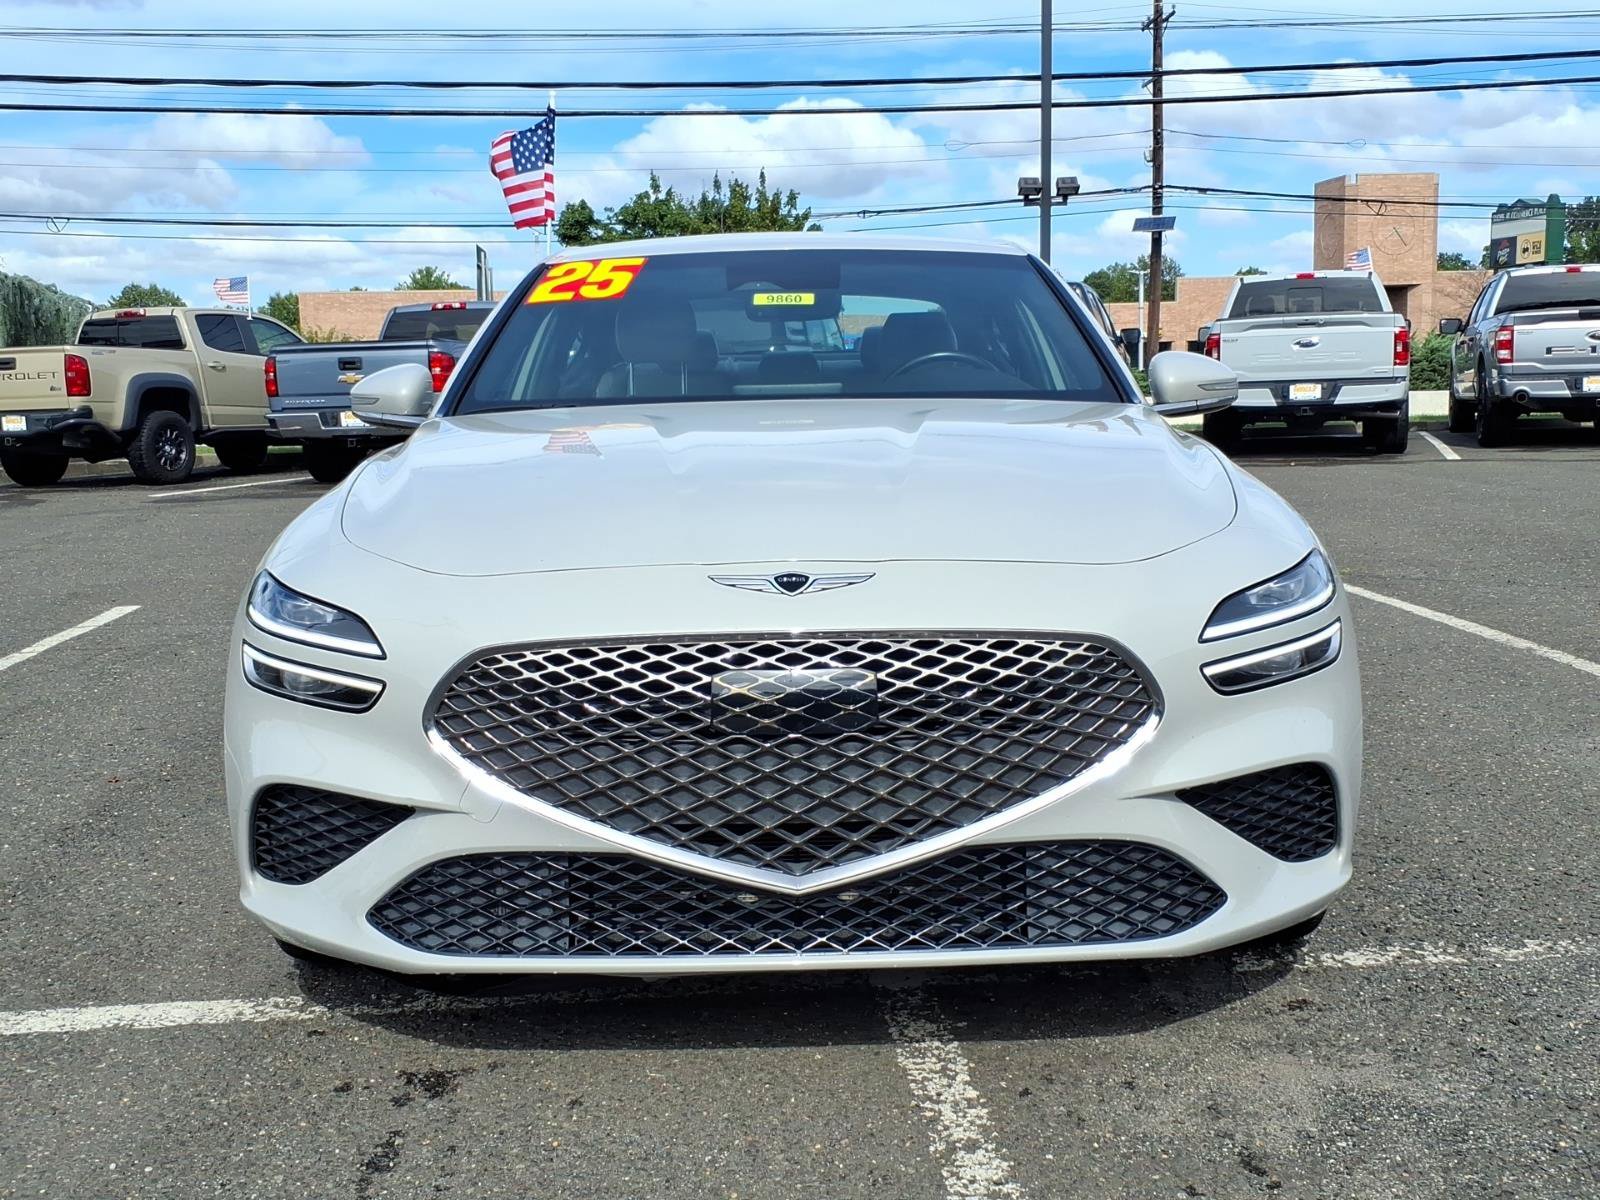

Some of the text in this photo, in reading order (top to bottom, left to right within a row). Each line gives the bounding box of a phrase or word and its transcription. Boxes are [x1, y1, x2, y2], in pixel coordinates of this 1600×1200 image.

[527, 257, 645, 304] 25
[766, 294, 802, 303] 9860
[1545, 345, 1600, 356] F-1
[0, 371, 59, 381] ROLET
